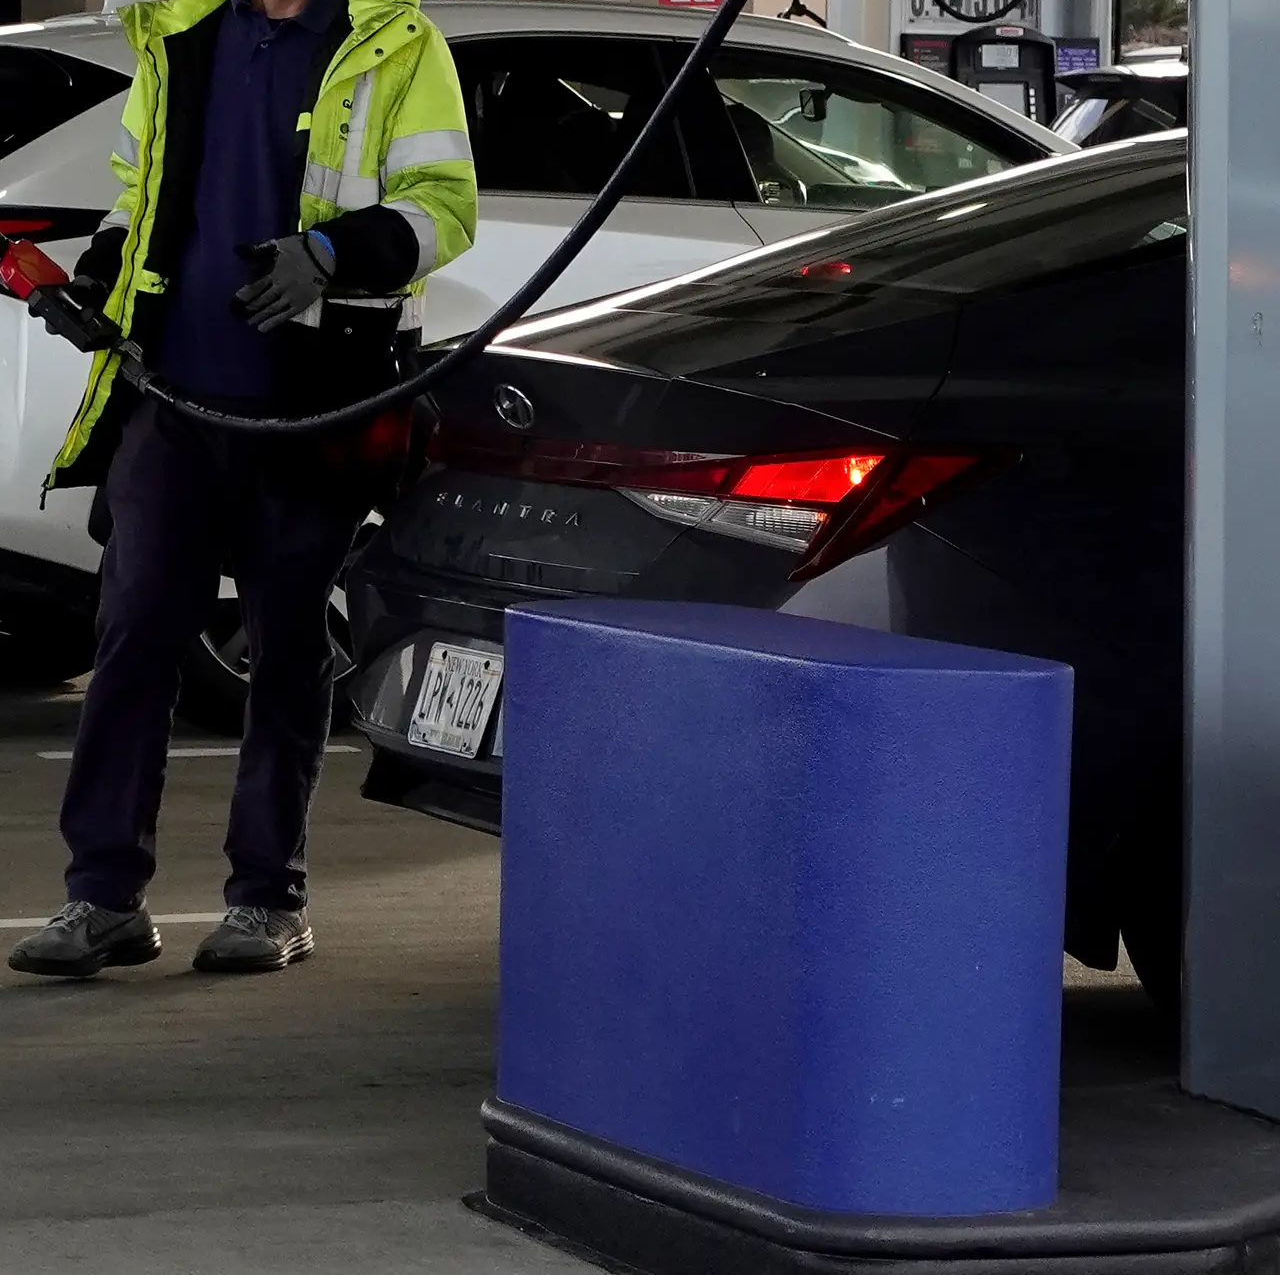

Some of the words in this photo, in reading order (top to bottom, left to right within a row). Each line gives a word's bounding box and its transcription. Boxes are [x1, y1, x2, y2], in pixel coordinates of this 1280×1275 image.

[436, 491, 580, 527] ELANTRA
[447, 654, 465, 677] NEW
[464, 657, 484, 679] YORK
